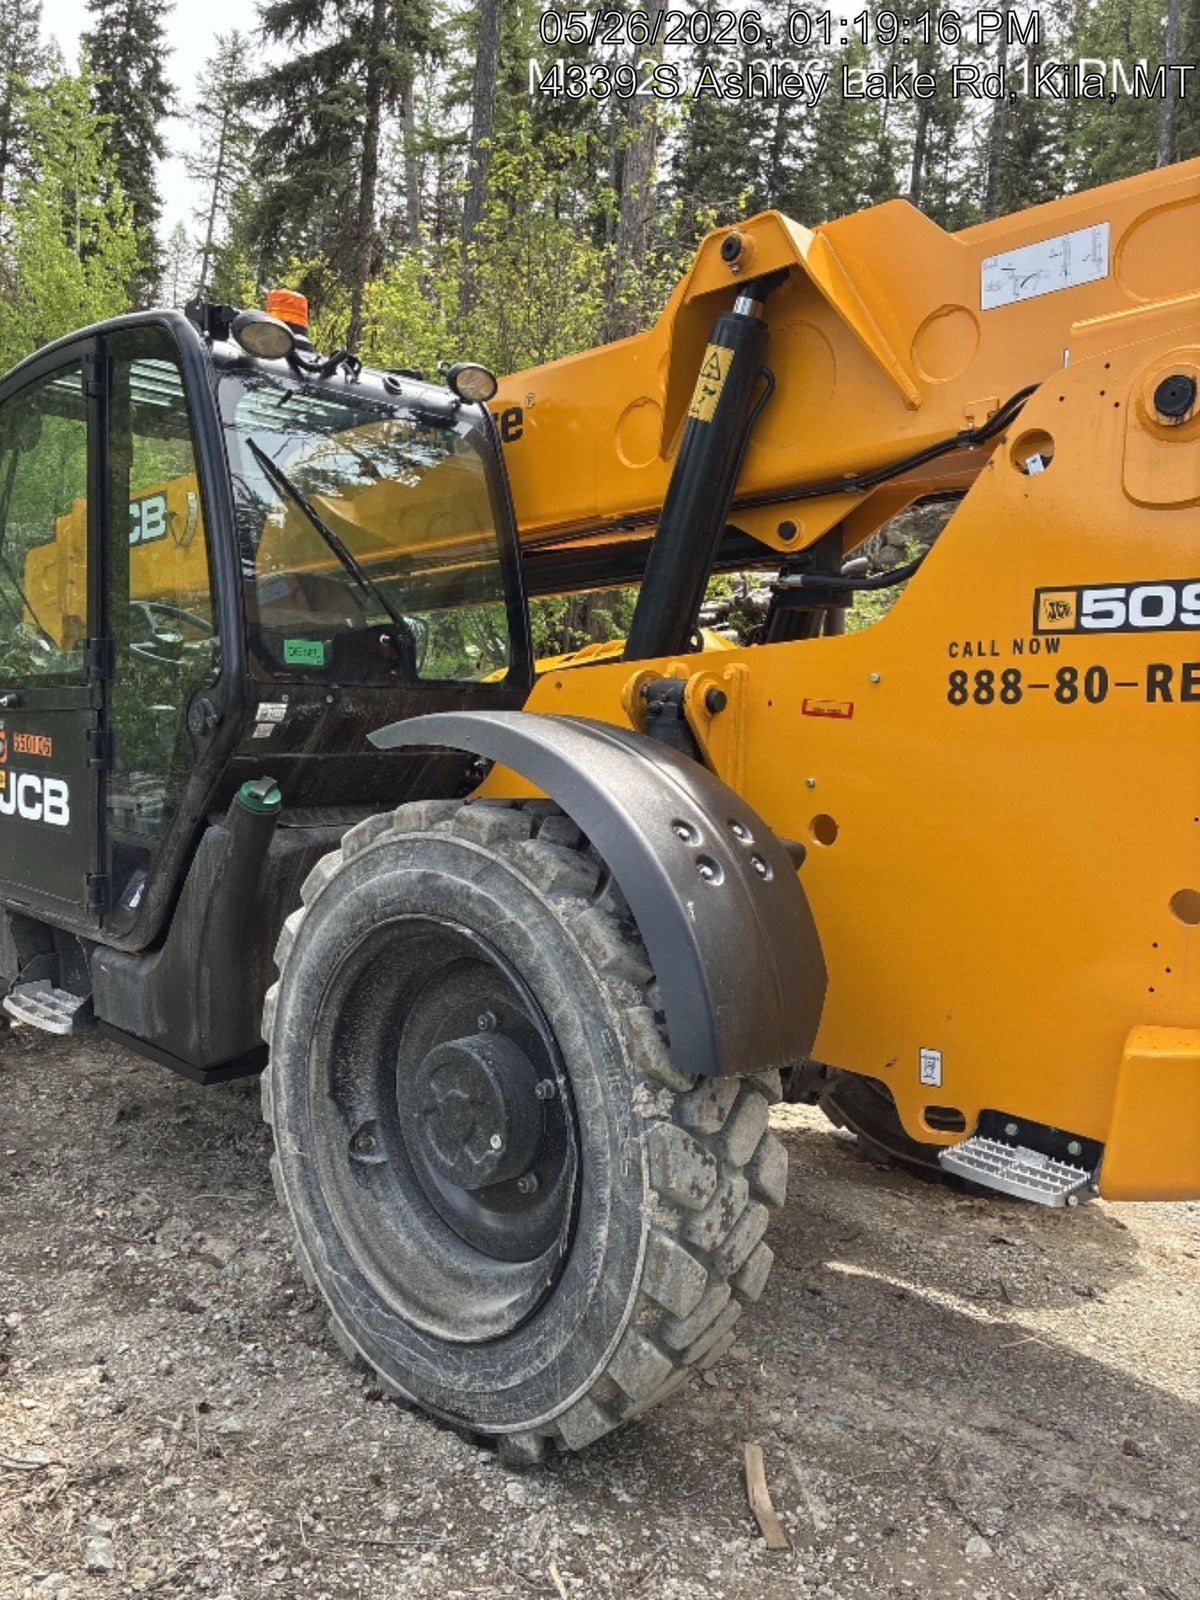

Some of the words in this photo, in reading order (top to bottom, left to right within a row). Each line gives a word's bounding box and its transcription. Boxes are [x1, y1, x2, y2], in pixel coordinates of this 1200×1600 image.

[948, 641, 1001, 659] CALL
[1012, 637, 1061, 656] NOW
[0, 771, 70, 826] JCB
